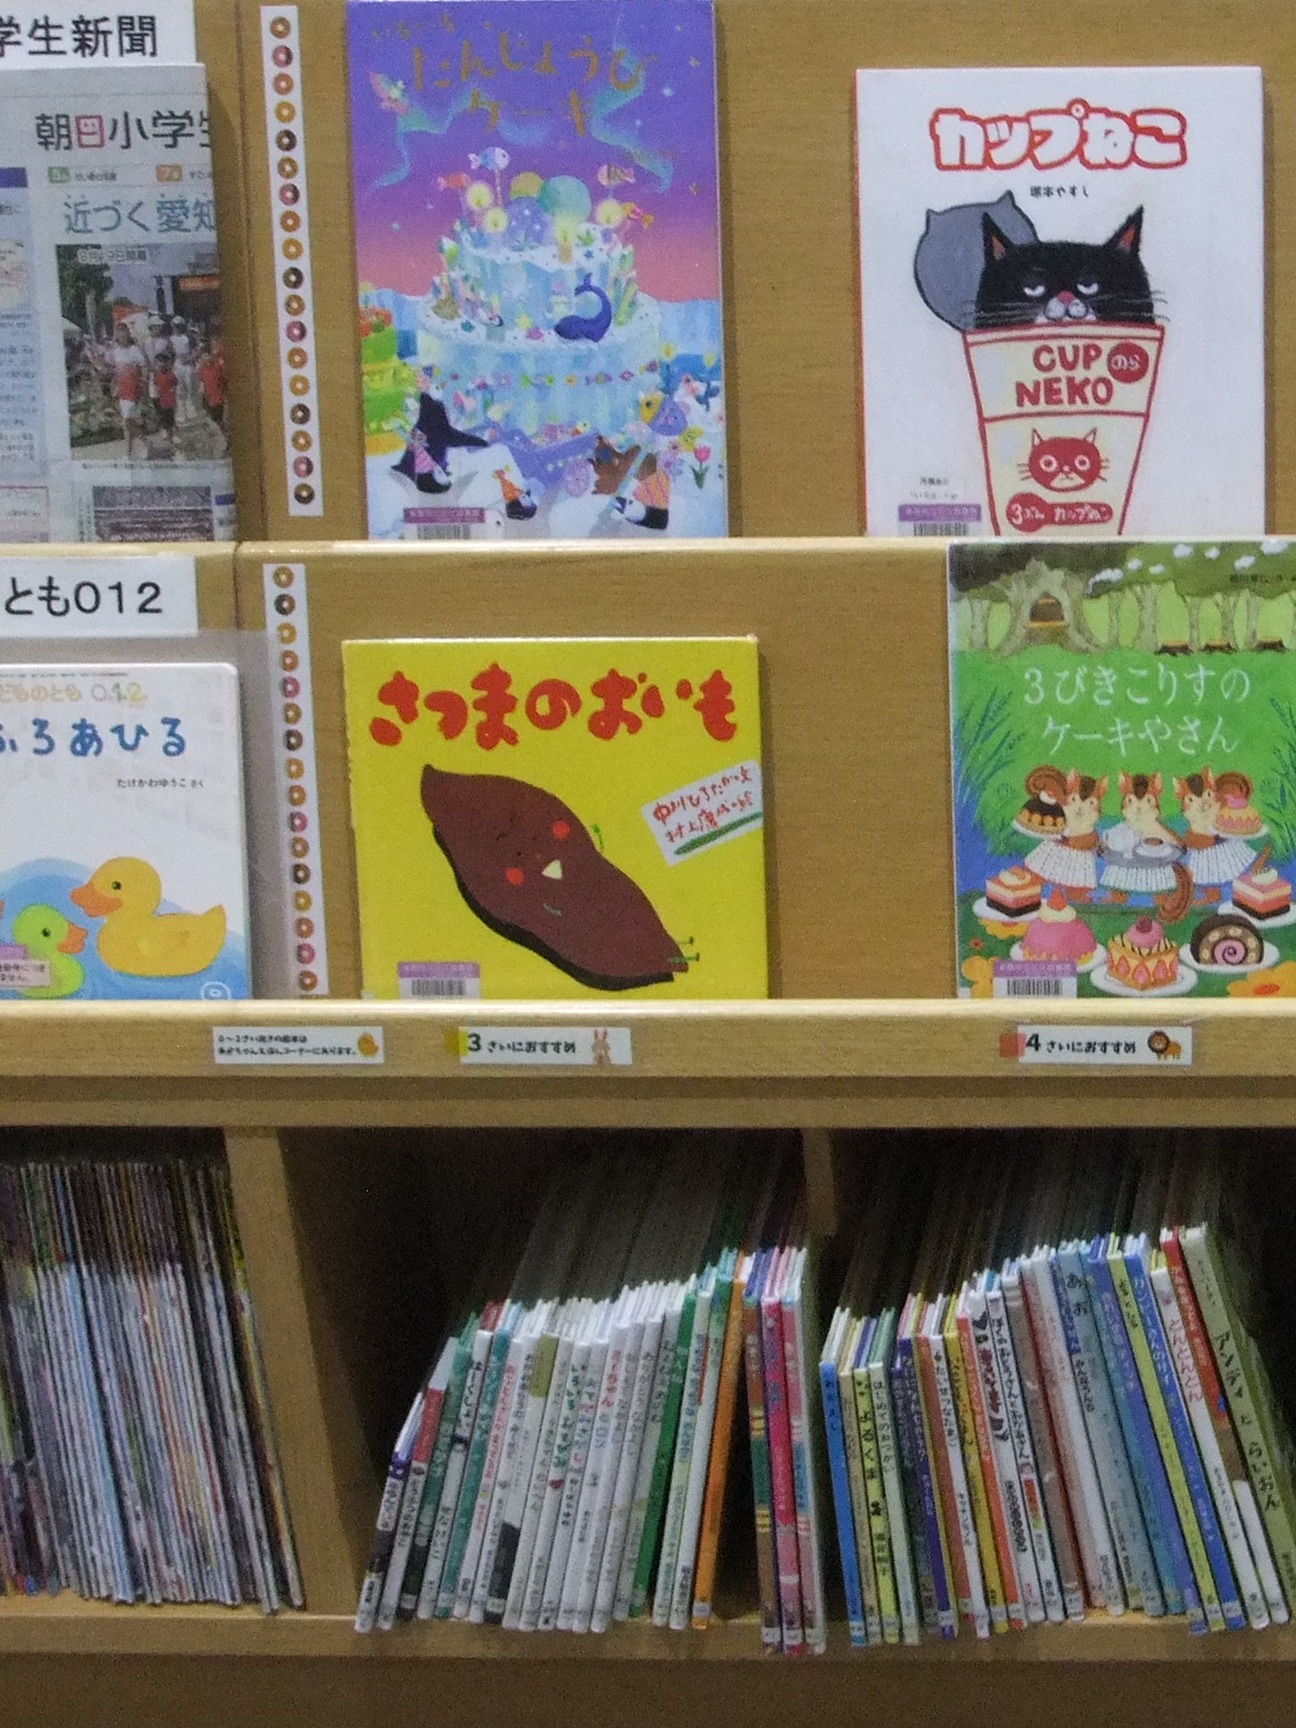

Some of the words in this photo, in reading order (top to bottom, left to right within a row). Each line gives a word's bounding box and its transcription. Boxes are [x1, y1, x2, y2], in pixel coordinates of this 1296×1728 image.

[35, 110, 210, 150] 朝日小学
[929, 97, 1188, 171] カップねこ
[1032, 344, 1100, 373] CUP
[1015, 376, 1114, 408] NEKO
[1024, 662, 1250, 706] 3びきこりすの
[369, 662, 737, 750] さつまのおいも
[1041, 714, 1239, 757] ケーキやさん
